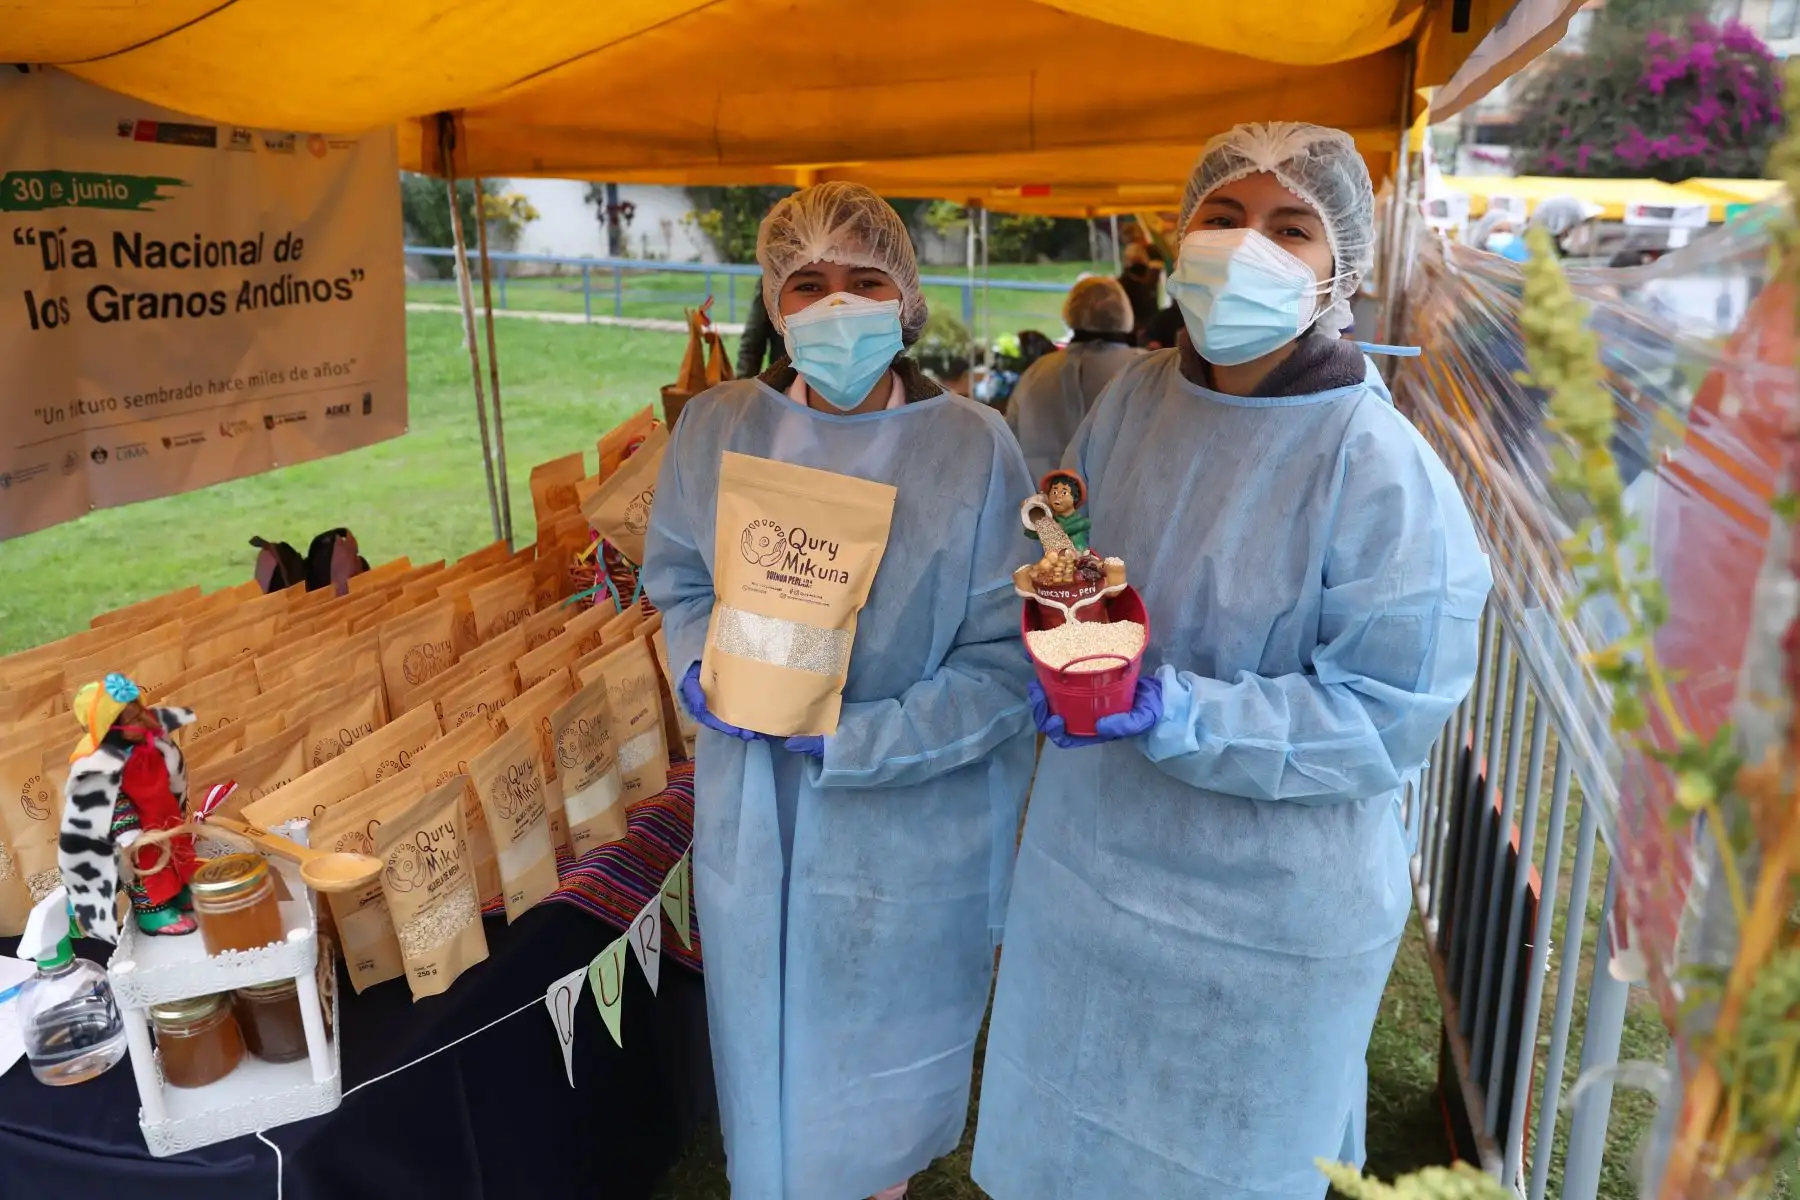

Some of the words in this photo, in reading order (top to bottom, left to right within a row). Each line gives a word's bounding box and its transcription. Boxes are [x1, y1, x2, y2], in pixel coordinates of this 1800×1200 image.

[12, 178, 44, 200] 30
[66, 177, 129, 205] junio
[112, 230, 264, 269] Nacional
[273, 232, 304, 262] de
[25, 289, 70, 330] los
[87, 284, 227, 323] Granos
[124, 382, 203, 409] sembrado
[208, 376, 243, 394] hace
[248, 370, 285, 388] miles
[289, 366, 308, 382] de
[788, 527, 839, 561] Qury
[781, 550, 849, 585] Mikuna
[422, 640, 452, 660] Qury
[338, 722, 372, 747] Qury
[508, 758, 533, 785] Qury
[416, 820, 456, 852] Qury
[417, 969, 431, 978] 250
